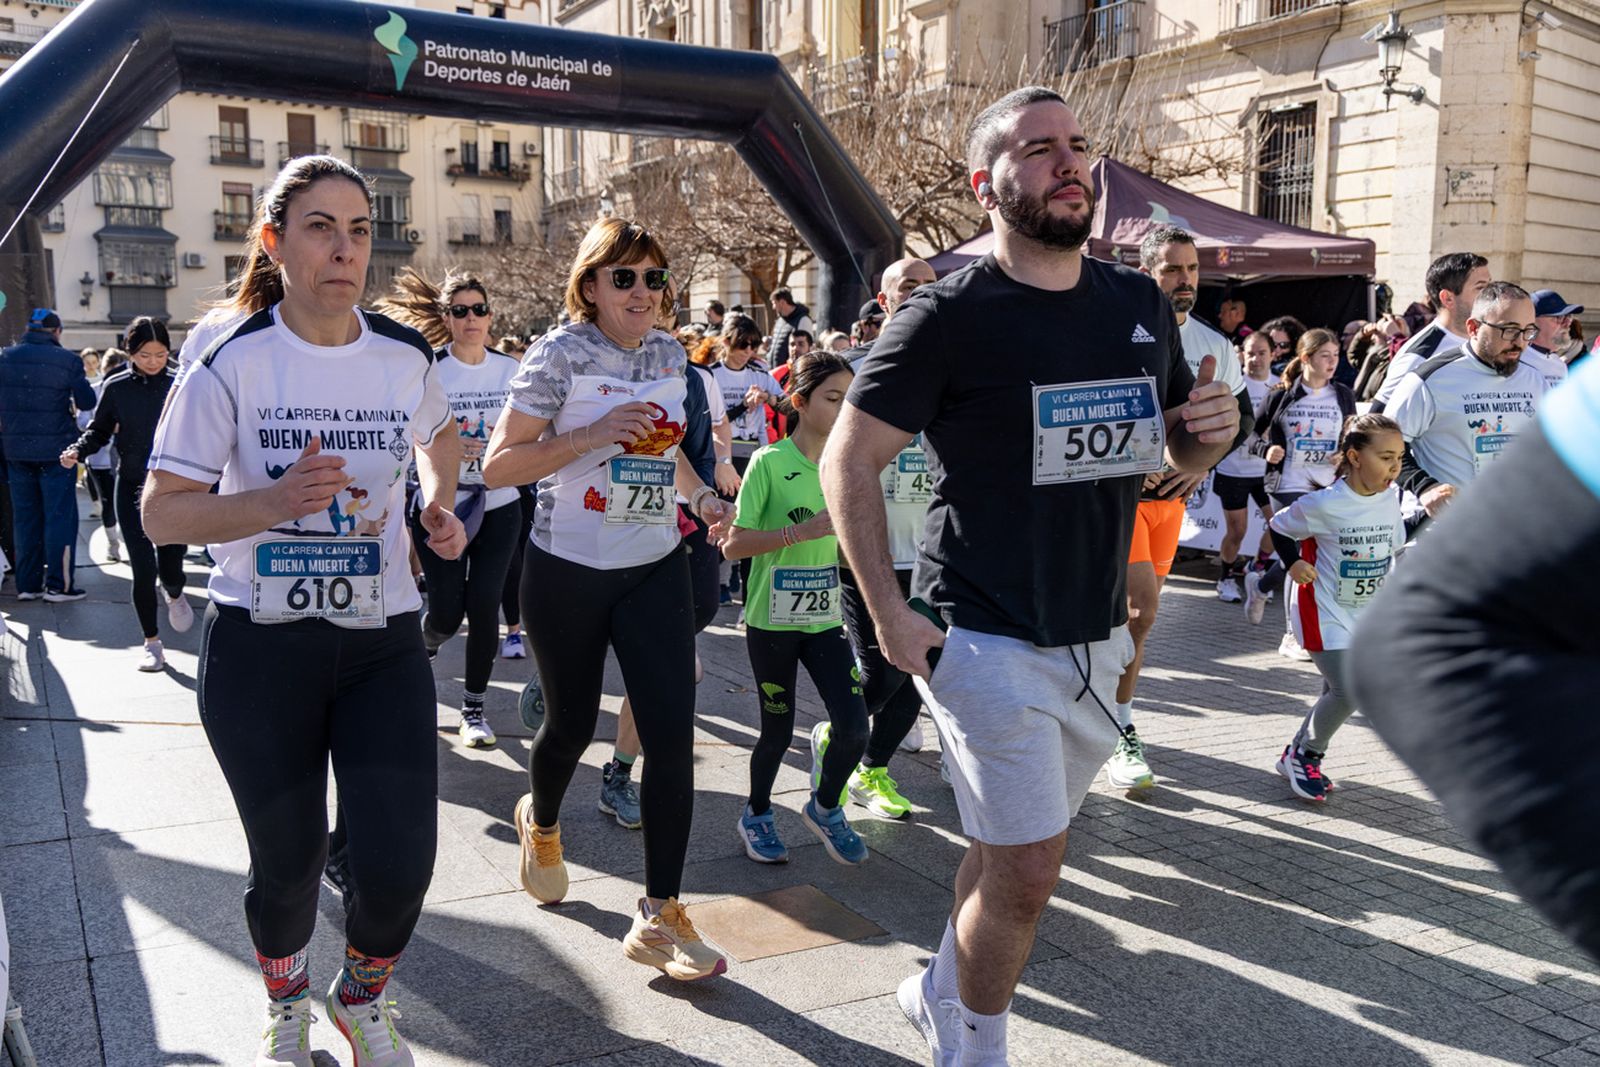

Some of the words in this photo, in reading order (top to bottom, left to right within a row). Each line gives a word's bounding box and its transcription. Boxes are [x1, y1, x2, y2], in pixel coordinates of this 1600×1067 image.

[423, 40, 507, 65] Patronato
[511, 50, 588, 75] Municipal
[592, 60, 612, 77] de
[424, 60, 502, 84] Deportes
[506, 70, 528, 87] de
[531, 73, 571, 92] Jaén
[1131, 335, 1156, 343] adidas
[1052, 395, 1061, 404] VI
[1062, 391, 1101, 404] CARRERA
[1101, 387, 1142, 400] CAMINATA
[1471, 392, 1501, 400] CARRERA
[1502, 391, 1533, 399] CAMINATA
[474, 399, 502, 410] MUERTE
[1464, 403, 1491, 415] BUENA
[1492, 402, 1522, 413] MUERTE
[257, 407, 271, 421] VI
[275, 407, 341, 422] CARRERA
[345, 409, 410, 422] CAMINATA
[1052, 405, 1086, 423] BUENA
[1088, 402, 1128, 419] MUERTE
[1287, 410, 1305, 418] BUENA
[1308, 411, 1330, 419] MUERTE
[259, 429, 313, 450] BUENA
[320, 430, 387, 450] MUERTE
[1064, 421, 1136, 461] 507
[1304, 451, 1327, 463] 237
[627, 461, 652, 469] CARRERA
[620, 470, 641, 482] BUENA
[642, 471, 663, 483] MUERTE
[627, 485, 665, 511] 723
[1346, 525, 1374, 534] CARRERA
[1338, 535, 1364, 545] BUENA
[1366, 533, 1389, 545] MUERTE
[271, 546, 280, 555] VI
[282, 546, 323, 555] CARRERA
[325, 546, 369, 555] CAMINATA
[270, 559, 306, 573] BUENA
[308, 559, 350, 573] MUERTE
[782, 579, 804, 589] BUENA
[805, 578, 828, 588] MUERTE
[287, 577, 353, 611] 610
[790, 590, 830, 612] 728
